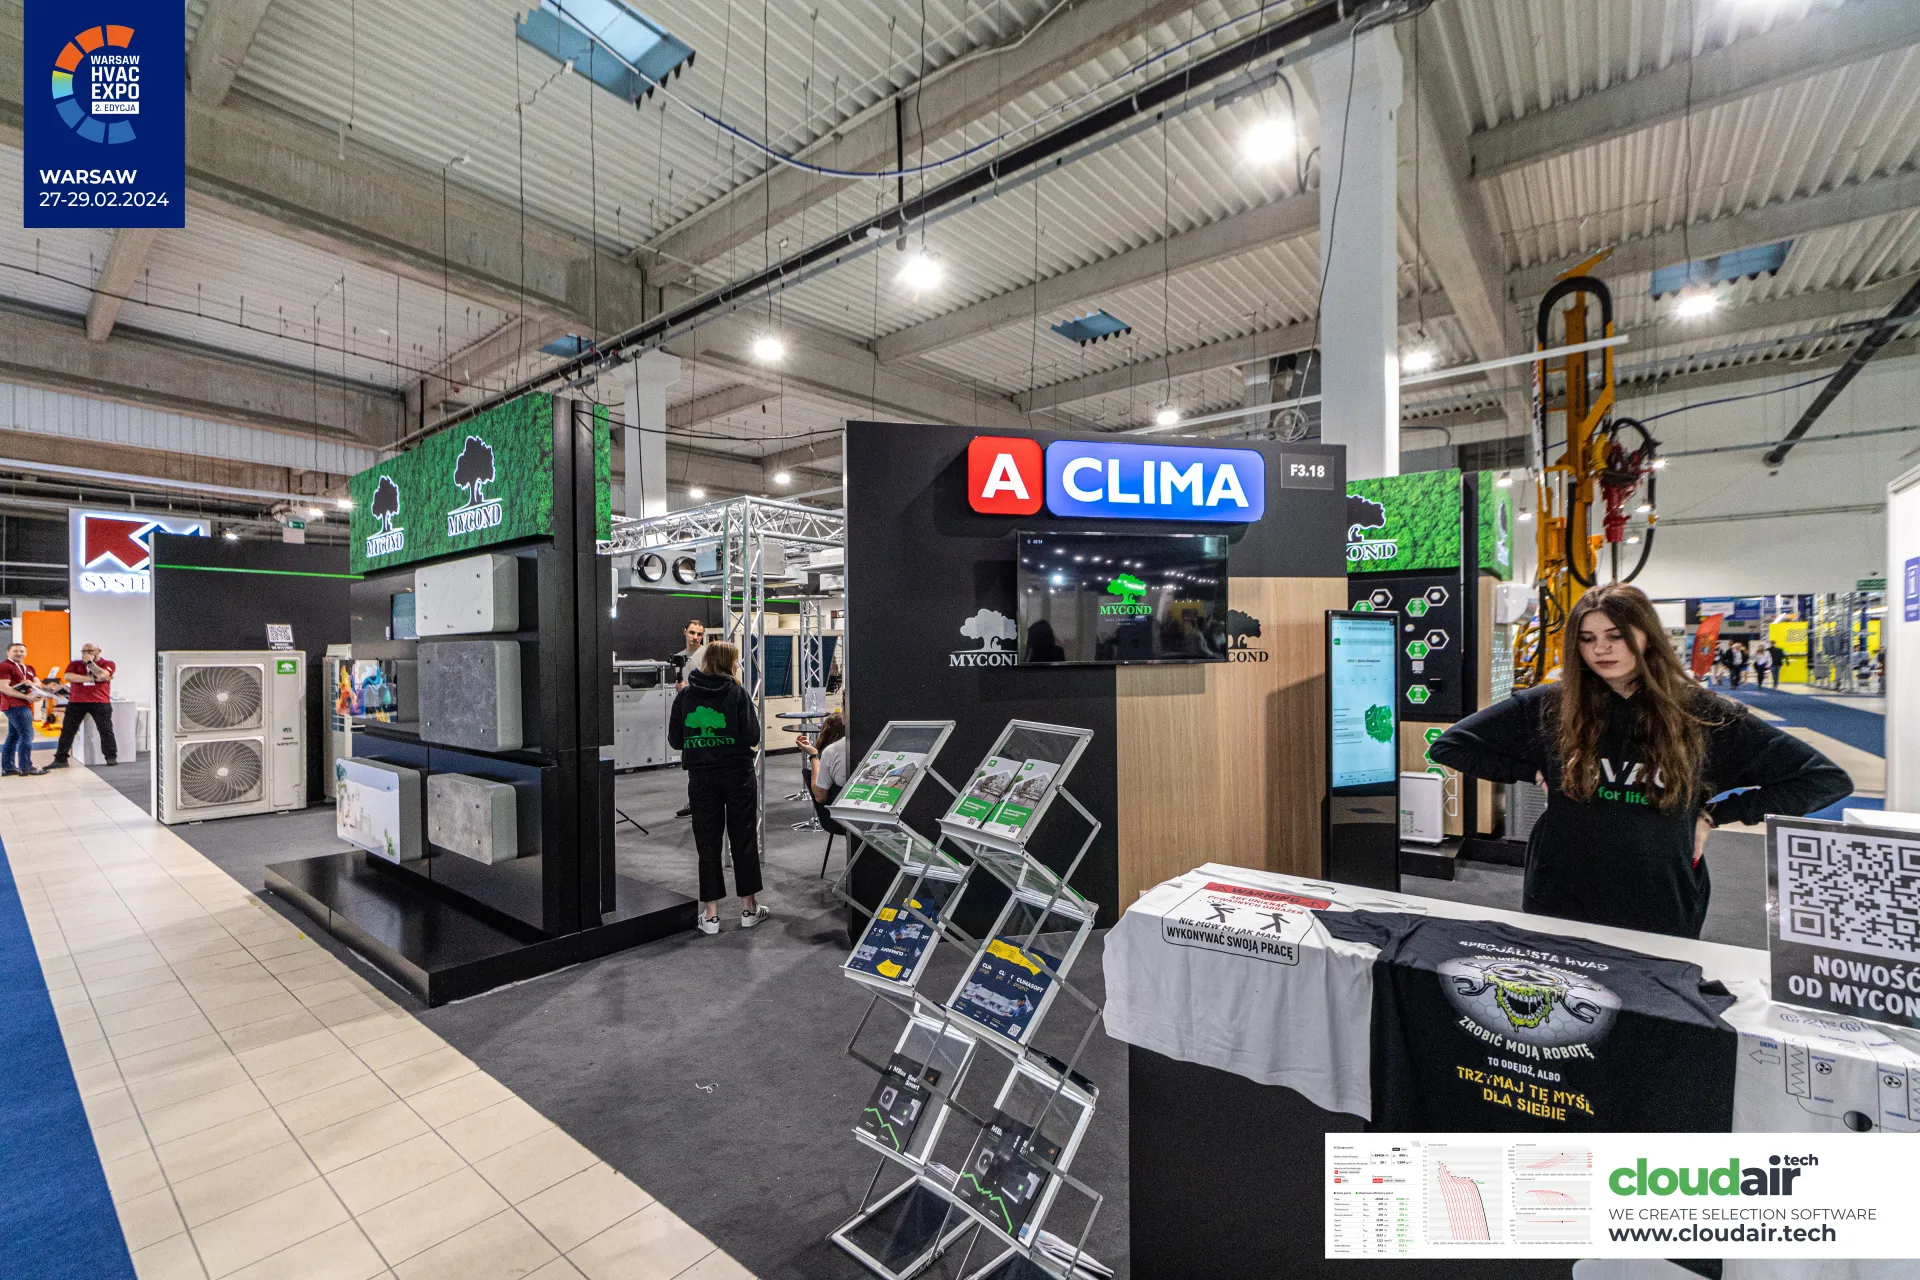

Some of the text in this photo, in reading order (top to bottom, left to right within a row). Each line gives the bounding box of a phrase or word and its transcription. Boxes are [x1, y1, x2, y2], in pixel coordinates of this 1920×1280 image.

[981, 453, 1249, 507] A CLIMA
[1290, 464, 1325, 478] F3.18
[447, 503, 503, 537] MYCOND
[366, 532, 405, 558] MYCOND
[1346, 543, 1398, 561] OND
[1099, 605, 1153, 615] MYCOND
[1227, 651, 1269, 663] COND
[1600, 757, 1666, 789] VAC
[1598, 786, 1649, 805] for life
[1232, 887, 1301, 903] WARNING
[1178, 917, 1194, 926] NIE
[1221, 925, 1234, 933] MI
[1235, 927, 1254, 936] JAK
[1255, 931, 1281, 941] MAM
[1167, 926, 1293, 960] WYKONYWAĆ SWOJĄ PRACĘ
[1788, 975, 1823, 999] OD
[1813, 955, 1920, 993] NOWOŚĆ
[1459, 1015, 1595, 1060] ZROBIĆ MOJĄ ROBOTĘ
[1487, 1056, 1561, 1082] TO ODEJDŹ, ALBO
[1456, 1066, 1595, 1115] TRZYMAJ TĘ MYŚL
[1483, 1087, 1566, 1121] DLA SIEBIE
